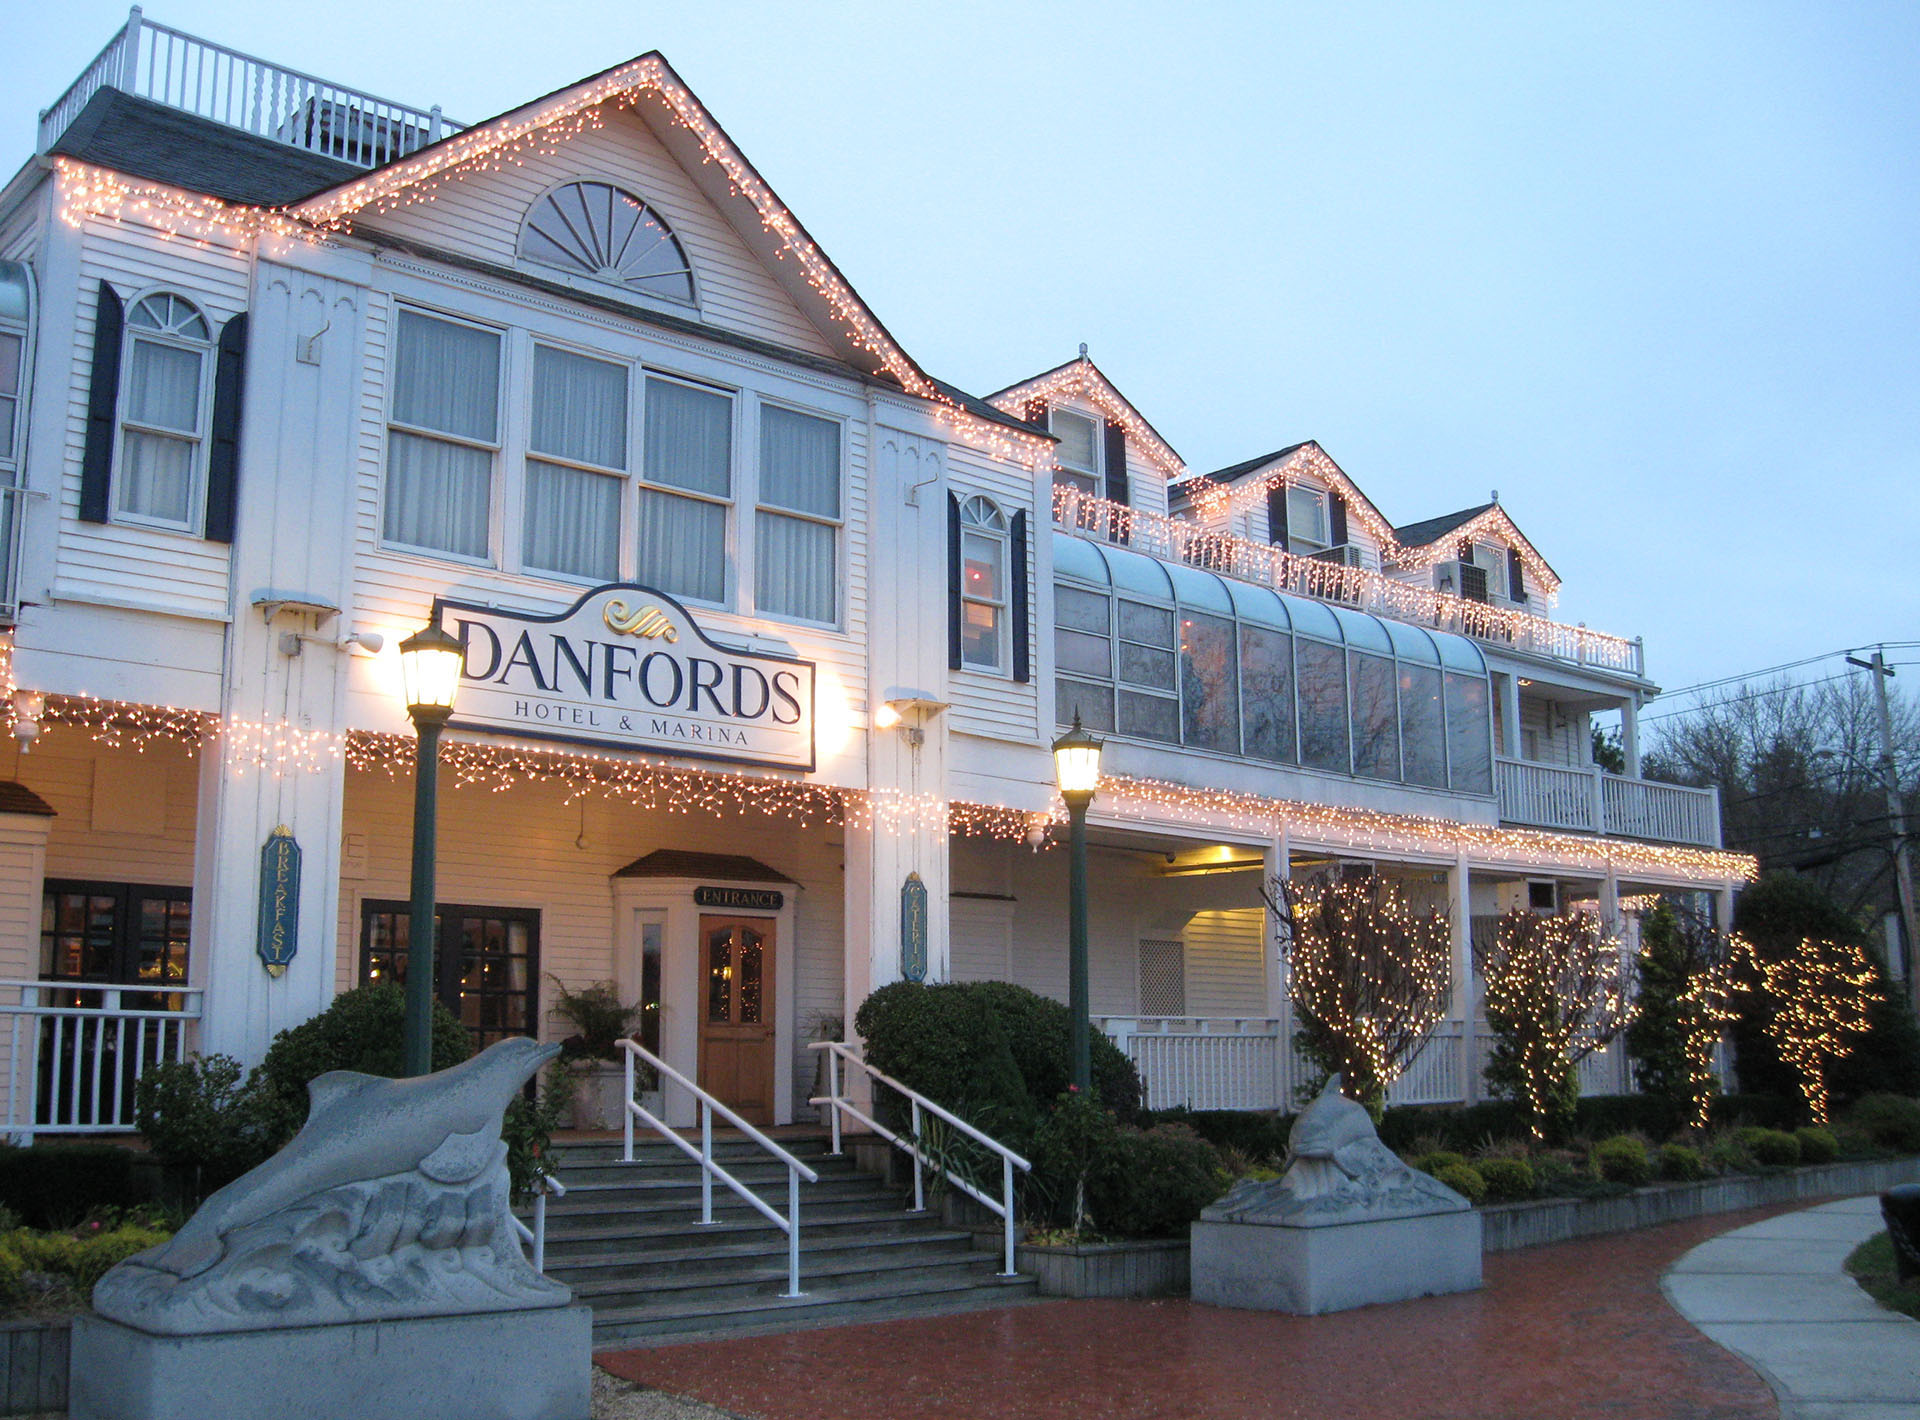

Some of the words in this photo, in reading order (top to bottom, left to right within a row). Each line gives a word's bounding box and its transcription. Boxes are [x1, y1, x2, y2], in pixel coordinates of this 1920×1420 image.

[455, 617, 801, 725] DANFORDS
[515, 700, 601, 727] HOTEL
[619, 716, 633, 731] &
[651, 719, 749, 745] MARINA
[272, 841, 290, 960] BREAKFAST
[703, 890, 777, 906] ENTRANCE
